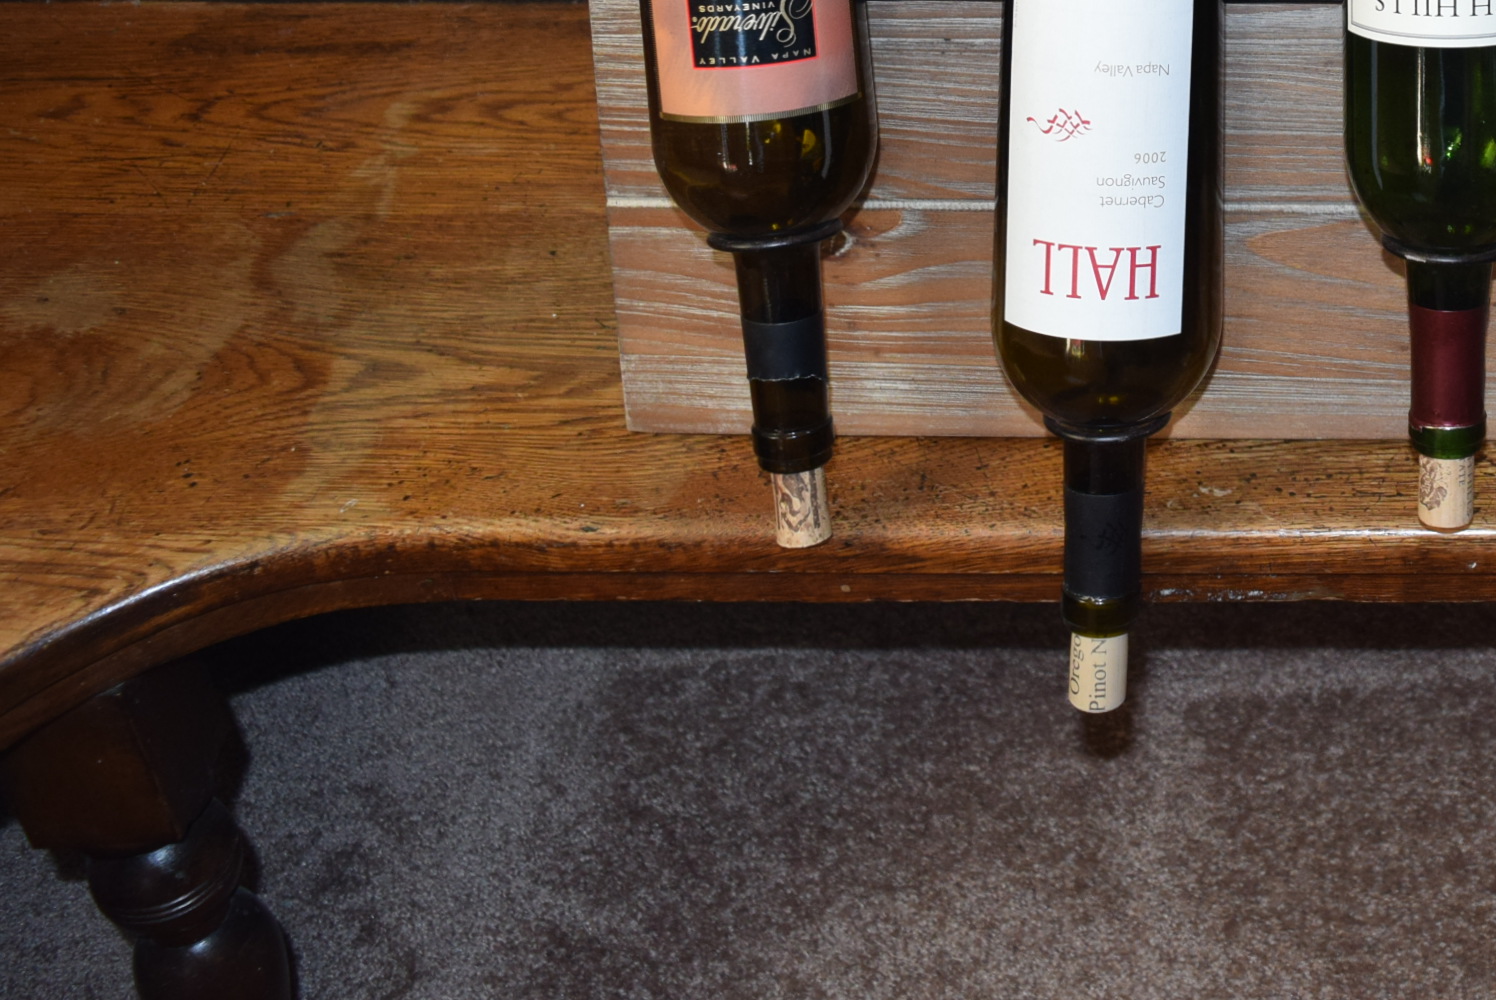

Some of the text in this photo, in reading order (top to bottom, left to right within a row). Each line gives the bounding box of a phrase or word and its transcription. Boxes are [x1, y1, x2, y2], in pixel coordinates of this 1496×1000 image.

[698, 1, 775, 13] VINEYARDS
[698, 47, 811, 65] NAPA VALLEY
[1094, 60, 1170, 77] Napa Valley
[1133, 151, 1167, 164] 2006
[1096, 173, 1166, 191] Sauvignon
[1099, 194, 1165, 209] Cabernet
[1032, 239, 1162, 301] HALL
[1089, 662, 1107, 711] Pinot
